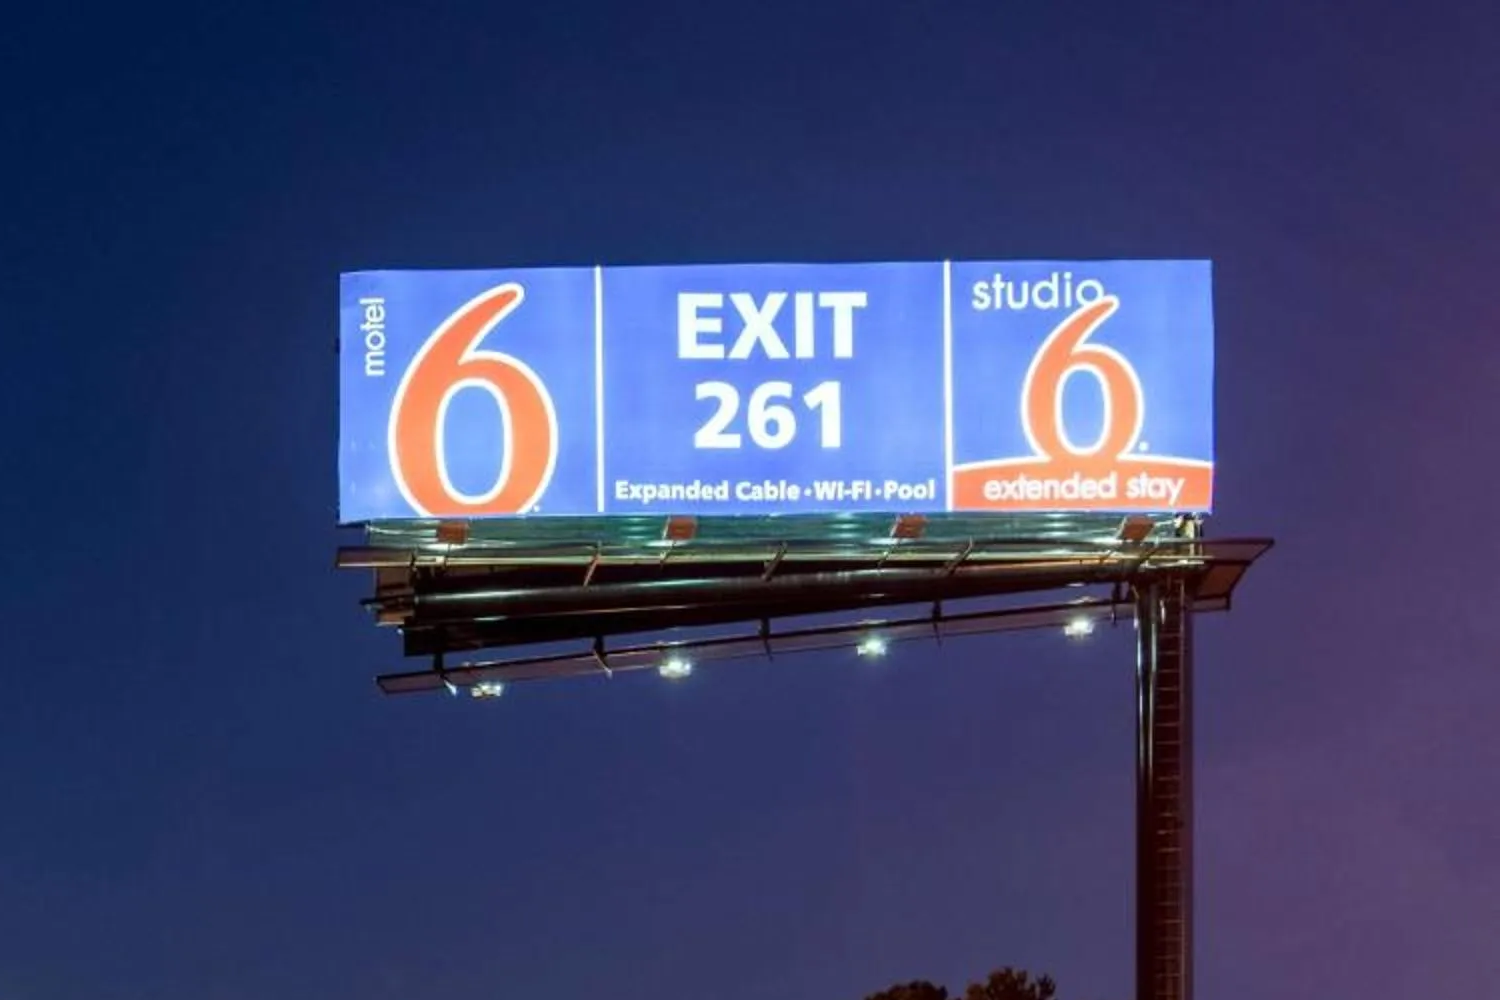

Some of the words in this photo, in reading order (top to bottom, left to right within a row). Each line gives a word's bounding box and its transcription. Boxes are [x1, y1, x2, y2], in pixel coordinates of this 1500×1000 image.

[677, 291, 868, 360] EXIT
[971, 272, 1104, 310] studio
[359, 297, 386, 377] motel
[388, 282, 558, 518] 6
[1021, 295, 1144, 462] 6
[694, 380, 842, 450] 261
[615, 479, 729, 504] Expanded
[736, 479, 800, 501] Cable
[884, 478, 936, 500] Pool
[983, 472, 1118, 501] extended
[1126, 472, 1186, 507] stay
